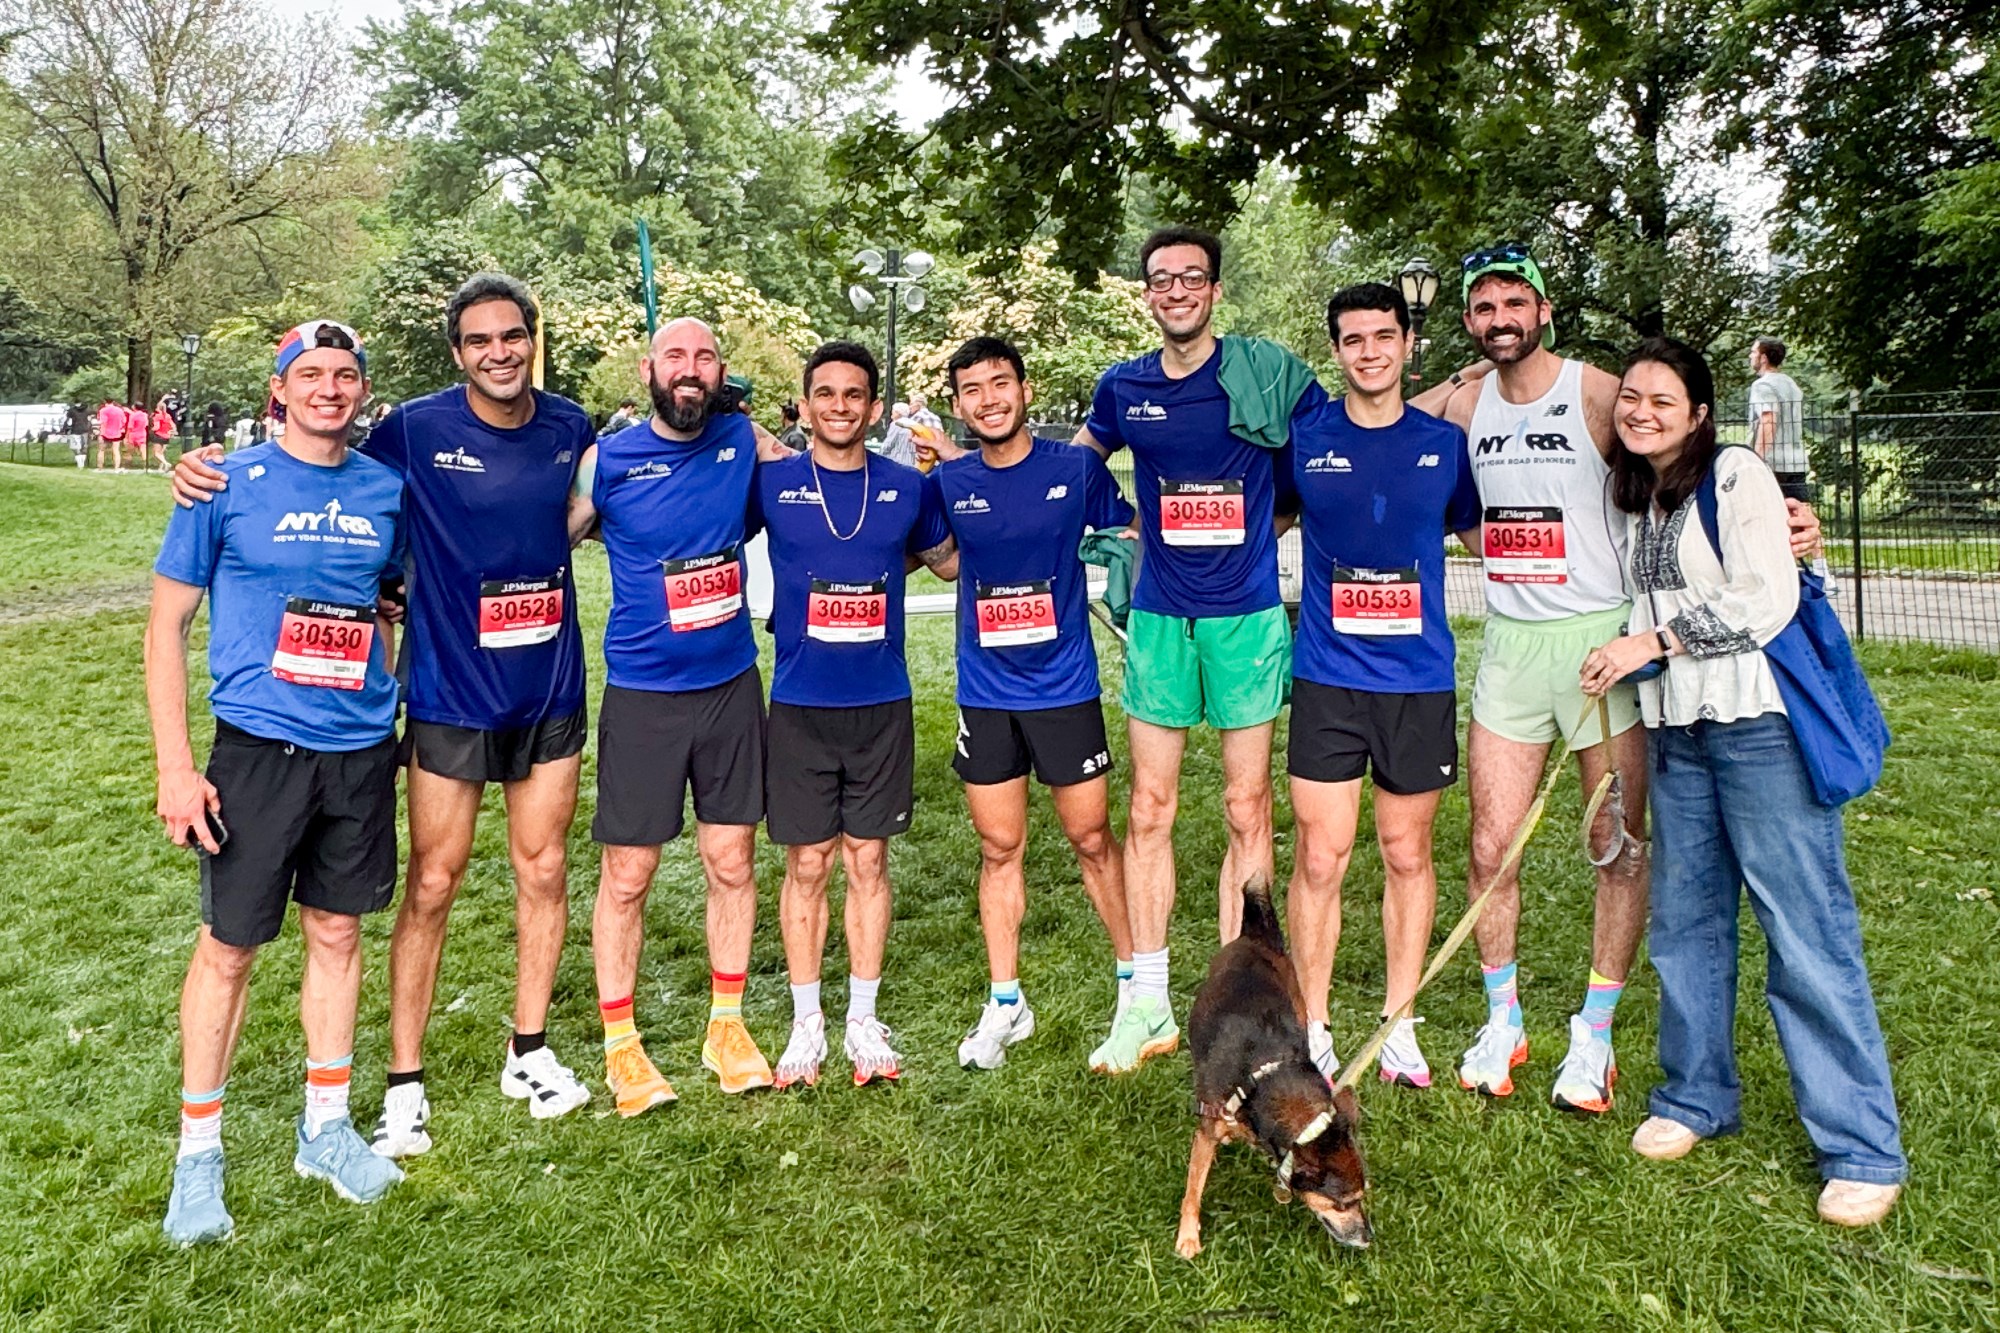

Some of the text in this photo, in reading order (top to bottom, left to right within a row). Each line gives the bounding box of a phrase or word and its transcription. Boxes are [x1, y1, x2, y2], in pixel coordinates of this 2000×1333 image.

[1533, 457, 1576, 465] RUNNERS
[1177, 483, 1224, 495] J.P.Morgan
[1169, 500, 1235, 520] 30536
[273, 534, 297, 543] NEW
[298, 534, 322, 542] YORK
[1490, 527, 1553, 548] 30531
[675, 567, 734, 598] 30537
[490, 596, 557, 622] 30528
[817, 599, 880, 619] 30538
[1341, 589, 1412, 609] 30533
[985, 600, 1046, 623] 30535
[289, 622, 363, 650] 30530
